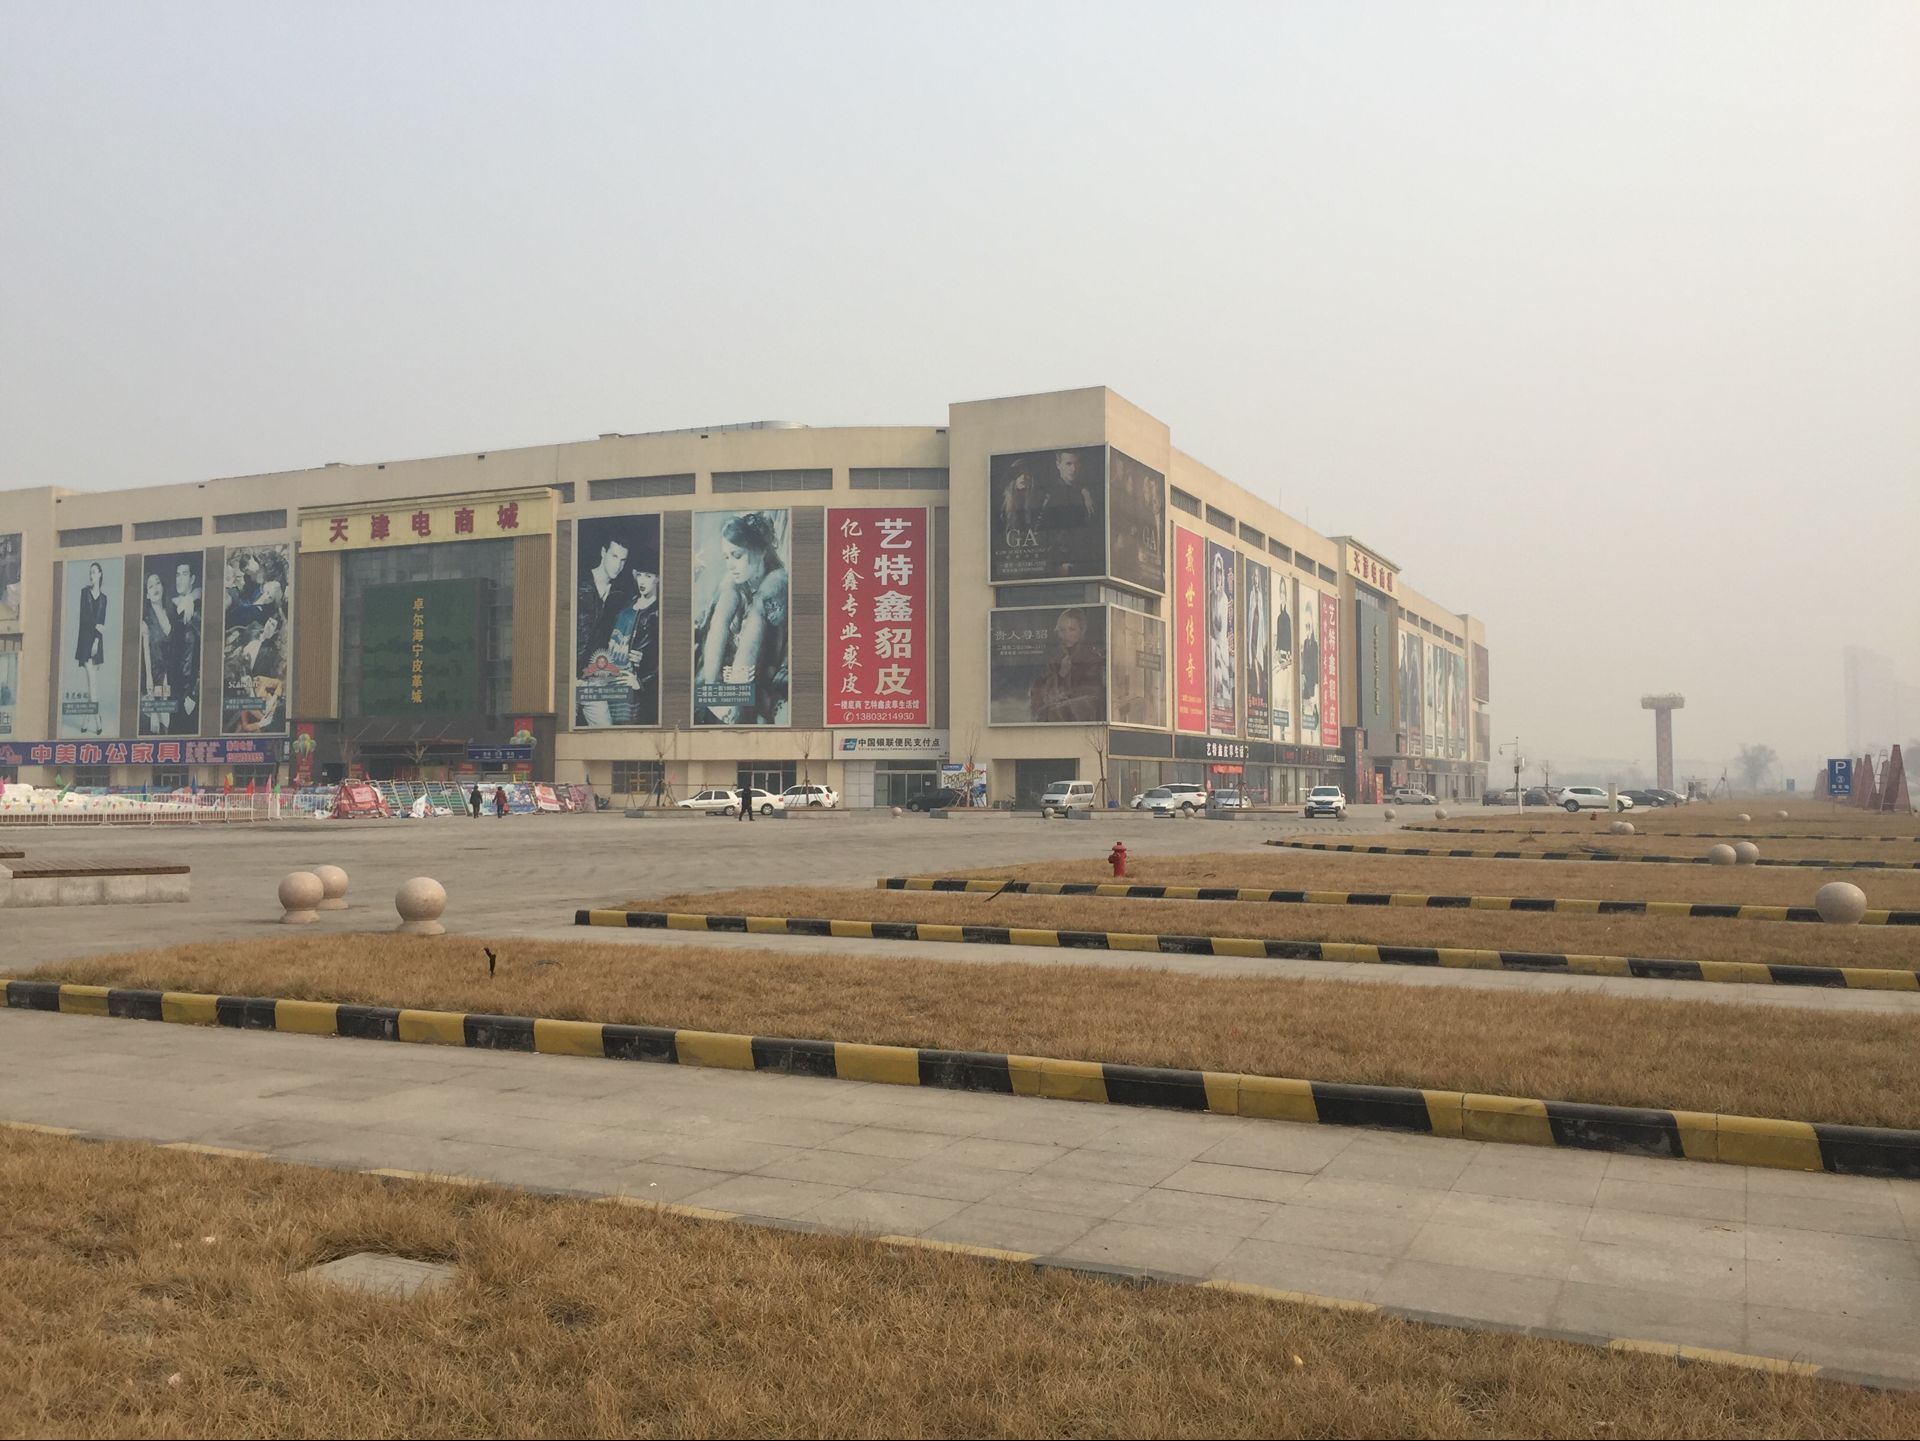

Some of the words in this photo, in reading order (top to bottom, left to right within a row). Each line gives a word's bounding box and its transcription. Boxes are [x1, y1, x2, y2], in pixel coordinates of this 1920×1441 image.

[328, 501, 520, 543] 天津电商城
[1006, 528, 1039, 548] GA
[873, 518, 914, 696] 艺特鑫貂皮
[411, 598, 424, 704] 卓尔海宁皮革城
[855, 712, 915, 721] 13803214930
[858, 737, 941, 747] 中国银联便民支付点
[30, 742, 181, 764] 中美办公家具
[1835, 761, 1847, 775] P
